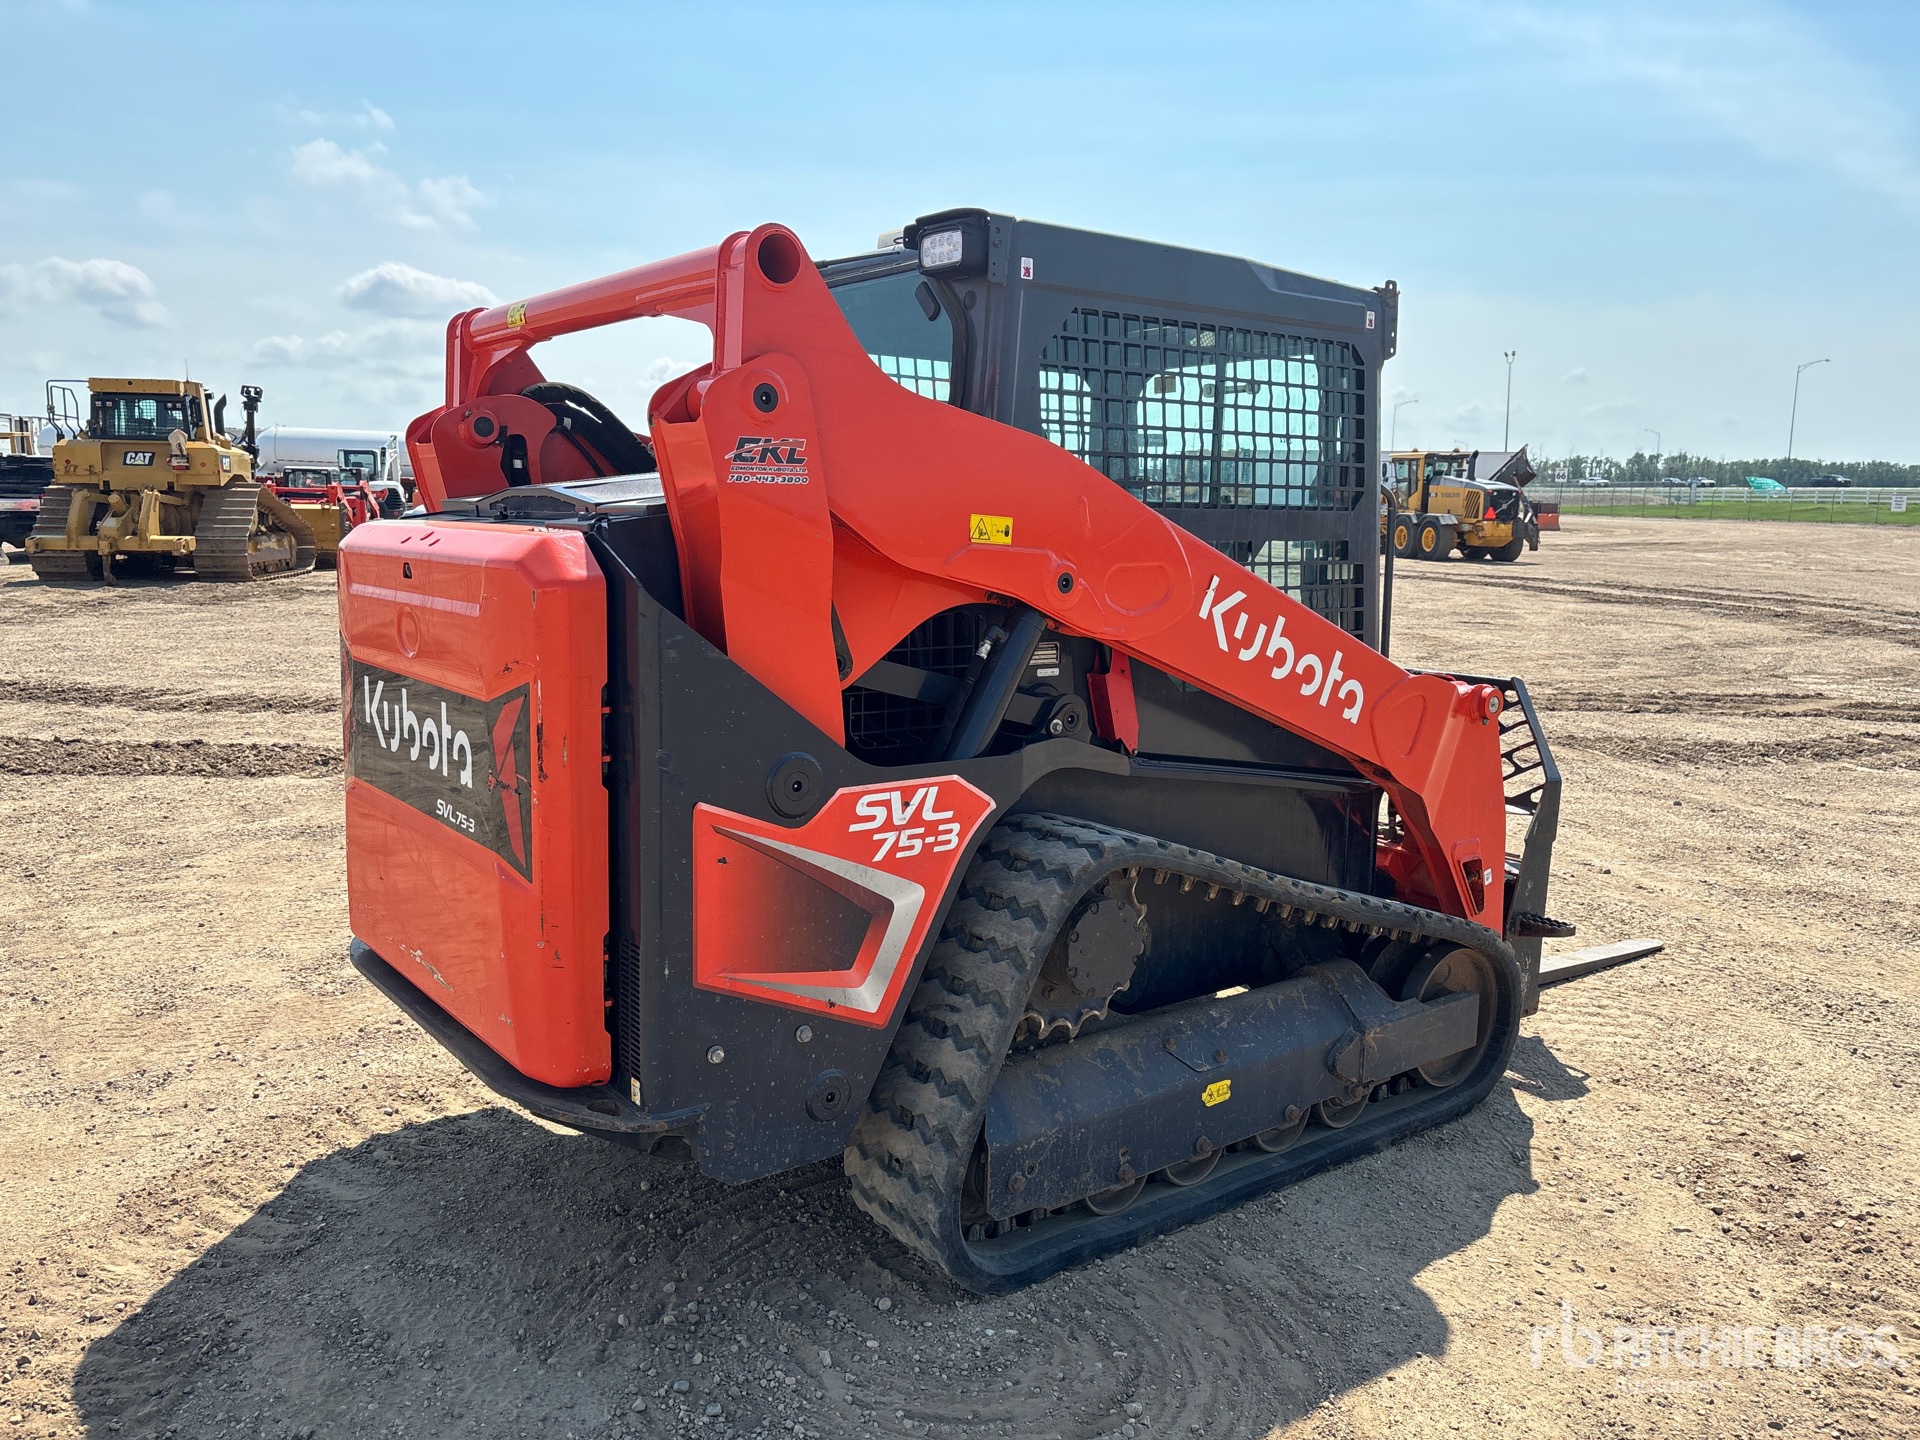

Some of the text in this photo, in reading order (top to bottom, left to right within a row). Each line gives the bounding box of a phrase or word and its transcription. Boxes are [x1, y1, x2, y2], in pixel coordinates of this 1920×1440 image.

[126, 452, 152, 464] CAT
[731, 436, 807, 465] EKL
[728, 474, 809, 484] 780-443-3800
[1556, 472, 1566, 480] 66
[1199, 574, 1364, 725] Kubota
[364, 675, 473, 789] Kubota
[436, 799, 475, 833] SVL75-3
[849, 786, 954, 832] SVL
[872, 822, 961, 862] 75-3
